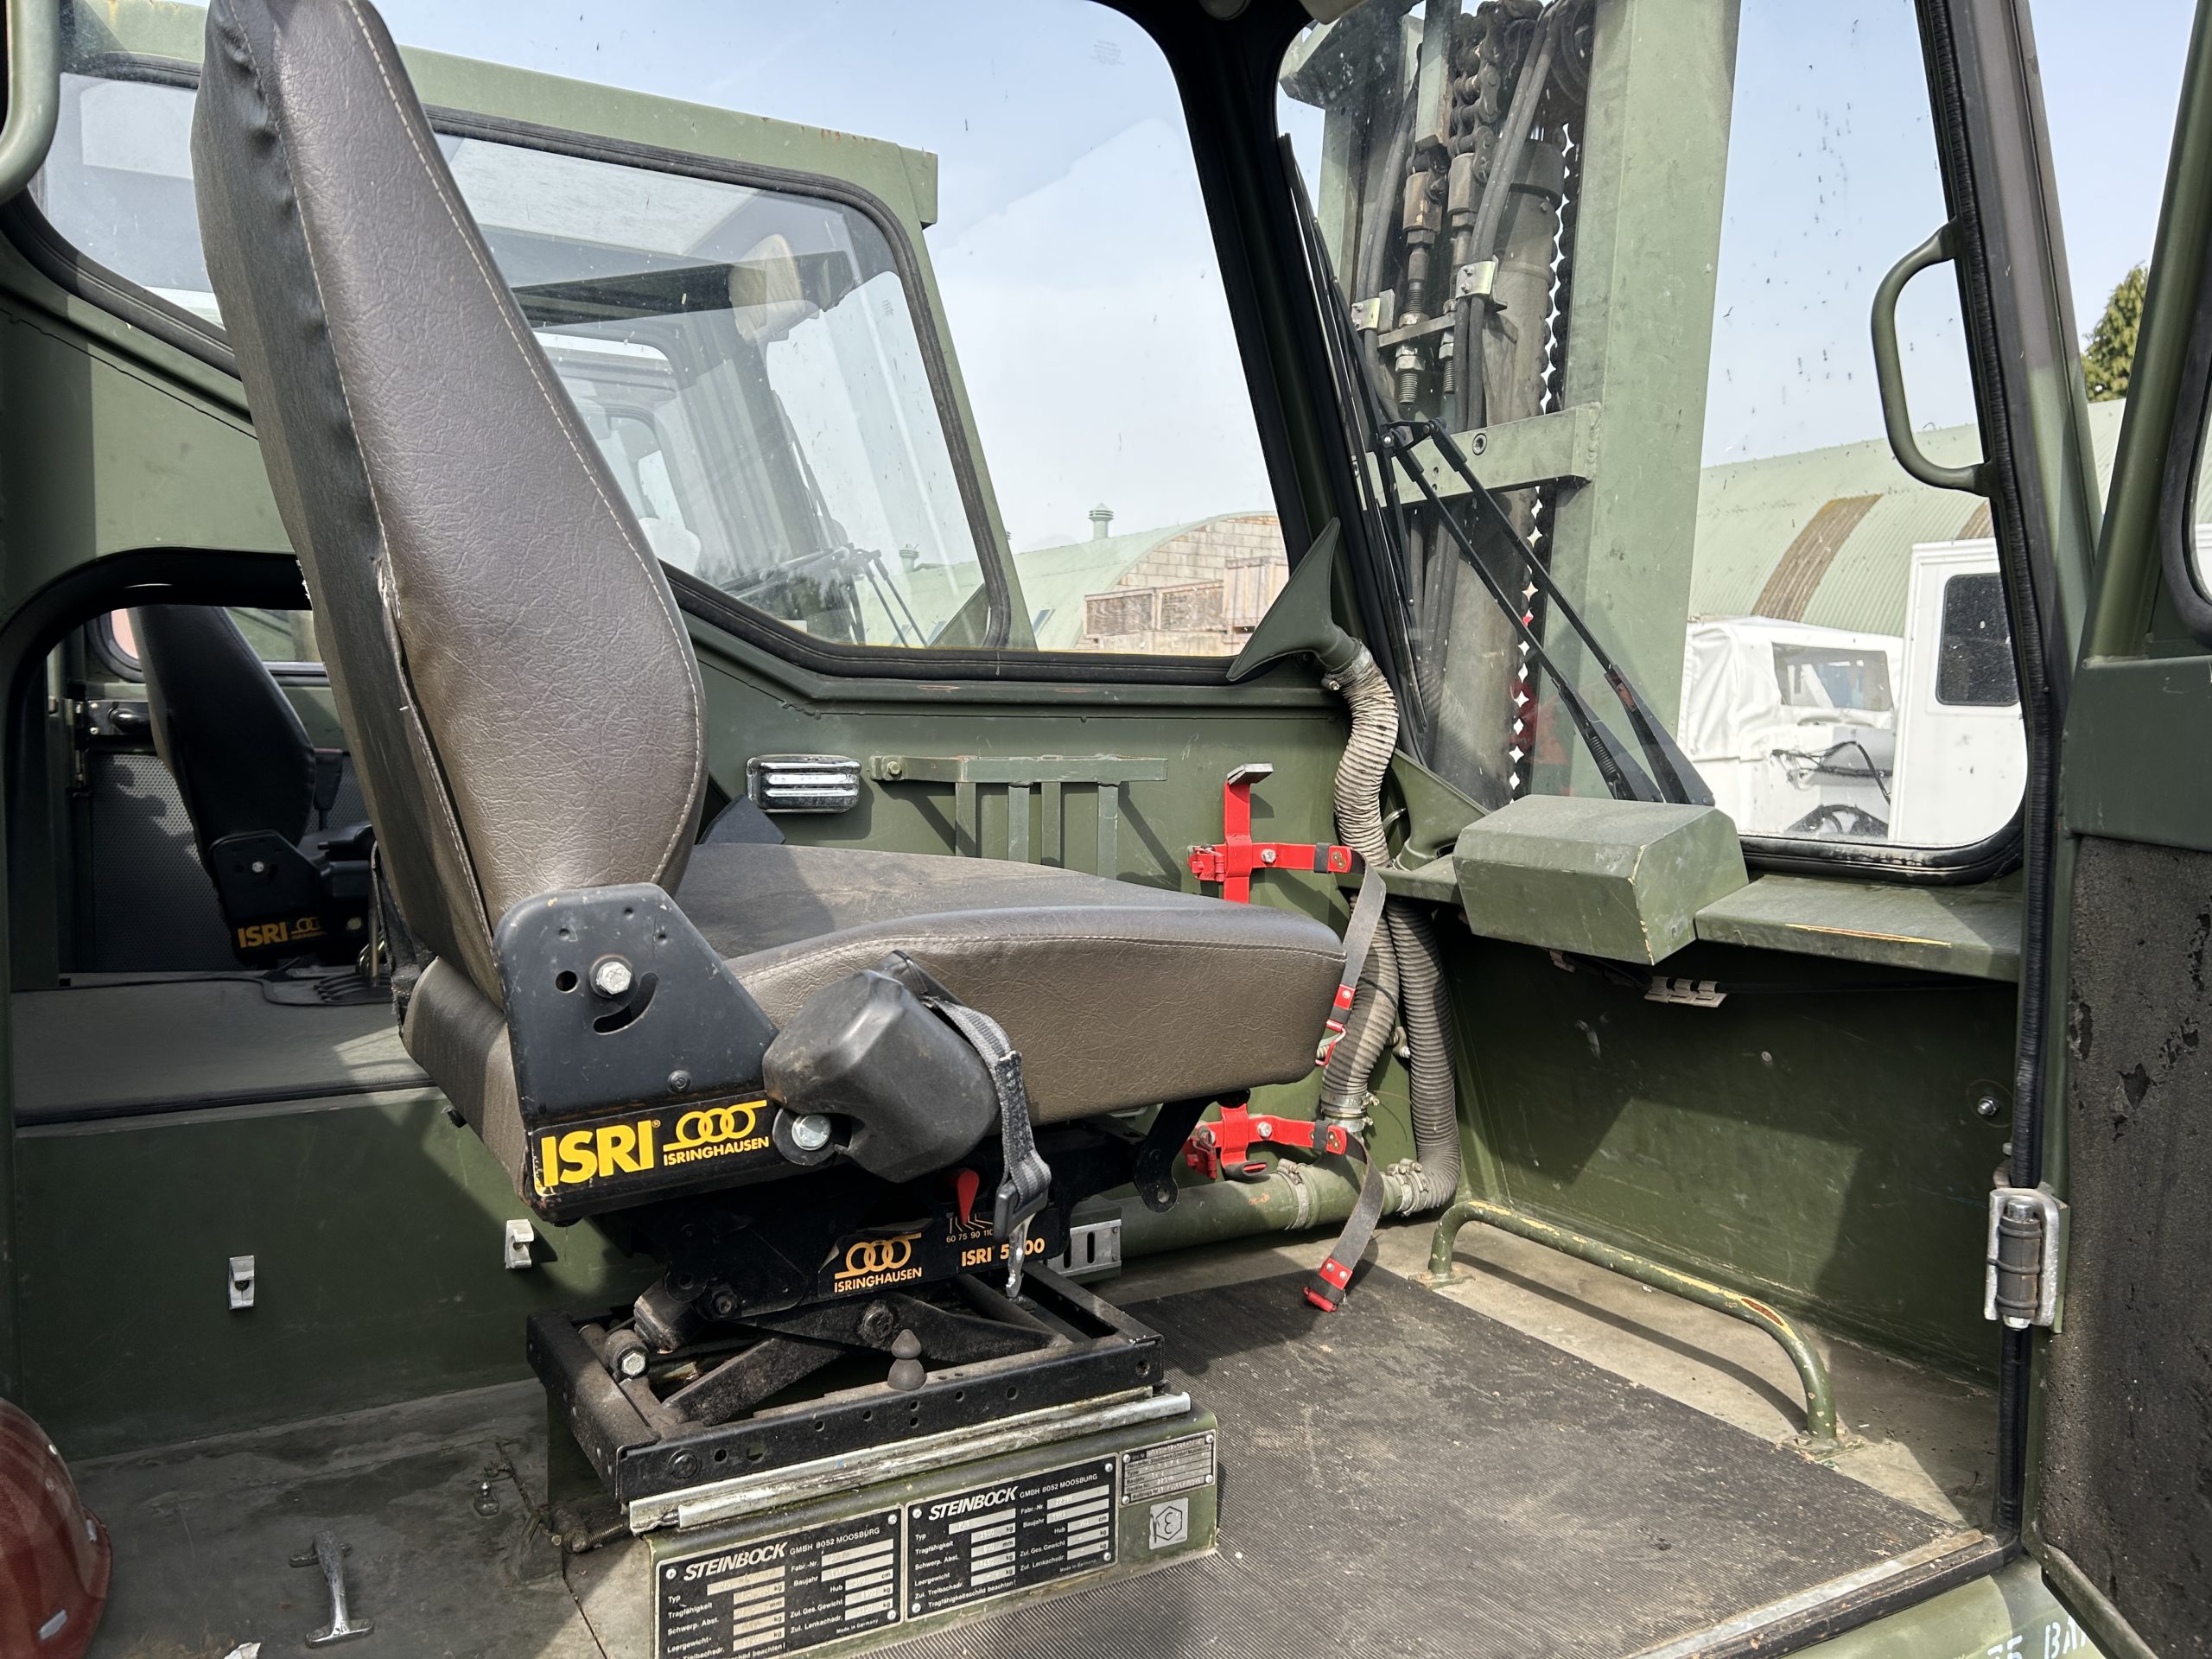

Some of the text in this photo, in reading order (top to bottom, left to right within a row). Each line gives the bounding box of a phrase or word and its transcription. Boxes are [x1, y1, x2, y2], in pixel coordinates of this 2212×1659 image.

[238, 921, 288, 948] ISRI
[664, 1136, 769, 1166] ISRINGHAUSEN
[946, 1235, 956, 1243] 60
[1000, 1237, 1046, 1260] 500
[834, 1267, 922, 1293] ISRINGHAUSEN
[928, 1473, 1097, 1521] STEINBOCK GMBH 8052 MOOSBURG
[1022, 1518, 1045, 1529] Baujahr
[915, 1541, 953, 1554] Tragfähigkeit
[980, 1529, 995, 1538] 2500
[1043, 1540, 1065, 1551] Gewicht
[683, 1541, 788, 1581] STEINBOCK
[789, 1544, 813, 1555] GMBH
[816, 1539, 835, 1549] 8052
[836, 1527, 880, 1544] MOOSBURG
[793, 1575, 818, 1586] Baujahr
[914, 1573, 950, 1586] Leergewicht
[830, 1585, 843, 1593] Hub
[668, 1602, 713, 1618] Tragfähigkeit
[817, 1599, 843, 1611] Gewicht
[856, 1618, 879, 1629] Germany
[2044, 1615, 2087, 1659] BA
